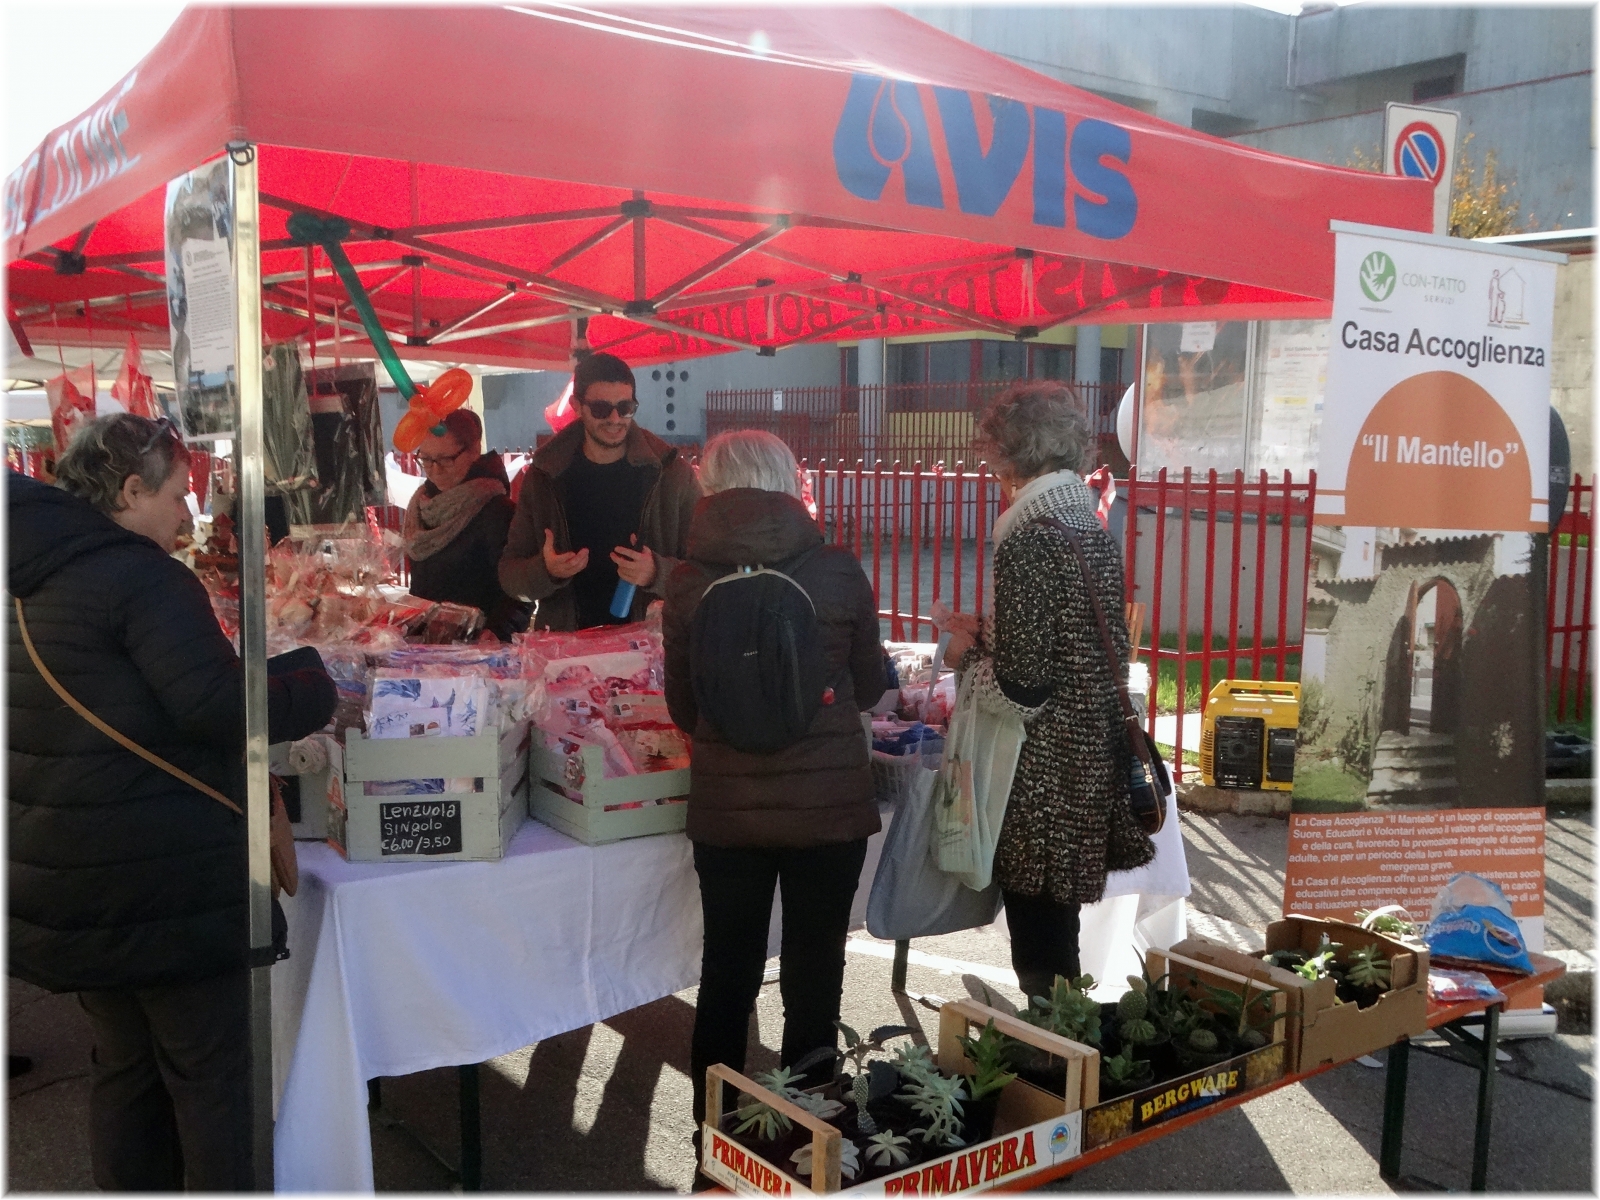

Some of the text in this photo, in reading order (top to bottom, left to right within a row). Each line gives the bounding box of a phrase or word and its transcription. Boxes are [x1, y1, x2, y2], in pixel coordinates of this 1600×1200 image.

[832, 72, 1138, 240] AVIS
[1402, 272, 1466, 294] CON-TATTO
[1341, 321, 1545, 368] Casa Accoglienza
[383, 803, 456, 820] Lenzuola
[1295, 817, 1307, 827] La
[1309, 817, 1332, 827] Casa
[1334, 815, 1384, 827] Accoglienza
[1457, 812, 1481, 823] luogo
[1483, 811, 1492, 821] di
[1325, 828, 1365, 838] Educatori
[1374, 827, 1415, 836] Volontari
[1417, 827, 1443, 835] vivono
[1450, 825, 1476, 833] valore
[1302, 843, 1308, 851] e
[1310, 842, 1332, 851] della
[1355, 839, 1400, 849] favorendo
[1401, 839, 1410, 847] la
[1412, 837, 1458, 849] promozione
[1460, 836, 1498, 846] integrale
[1500, 836, 1508, 844] di
[1510, 835, 1536, 844] donne
[1322, 853, 1339, 862] che
[1340, 854, 1353, 863] per
[1355, 853, 1367, 861] un
[1368, 851, 1402, 861] periodo
[1404, 850, 1426, 859] della
[1427, 850, 1442, 858] loro
[1483, 847, 1492, 856] in
[1493, 847, 1536, 856] situazione
[1380, 863, 1430, 873] emergenza
[1291, 877, 1303, 886] La
[1305, 877, 1328, 886] Casa
[1330, 876, 1338, 885] di
[1340, 875, 1392, 886] Accoglienza
[1394, 873, 1416, 883] offre
[1417, 874, 1429, 882] un
[1519, 869, 1541, 878] socio
[1295, 888, 1339, 898] educativa
[1341, 887, 1356, 896] che
[1357, 886, 1408, 896] comprende
[1512, 881, 1537, 890] carico
[1290, 901, 1313, 910] della
[1314, 899, 1358, 909] situazione
[1520, 892, 1528, 901] di
[1529, 893, 1540, 901] un
[1140, 1070, 1239, 1122] BERGWARE
[712, 1133, 792, 1198] PRIMAVERA
[884, 1131, 1037, 1198] PRIMAVERA
